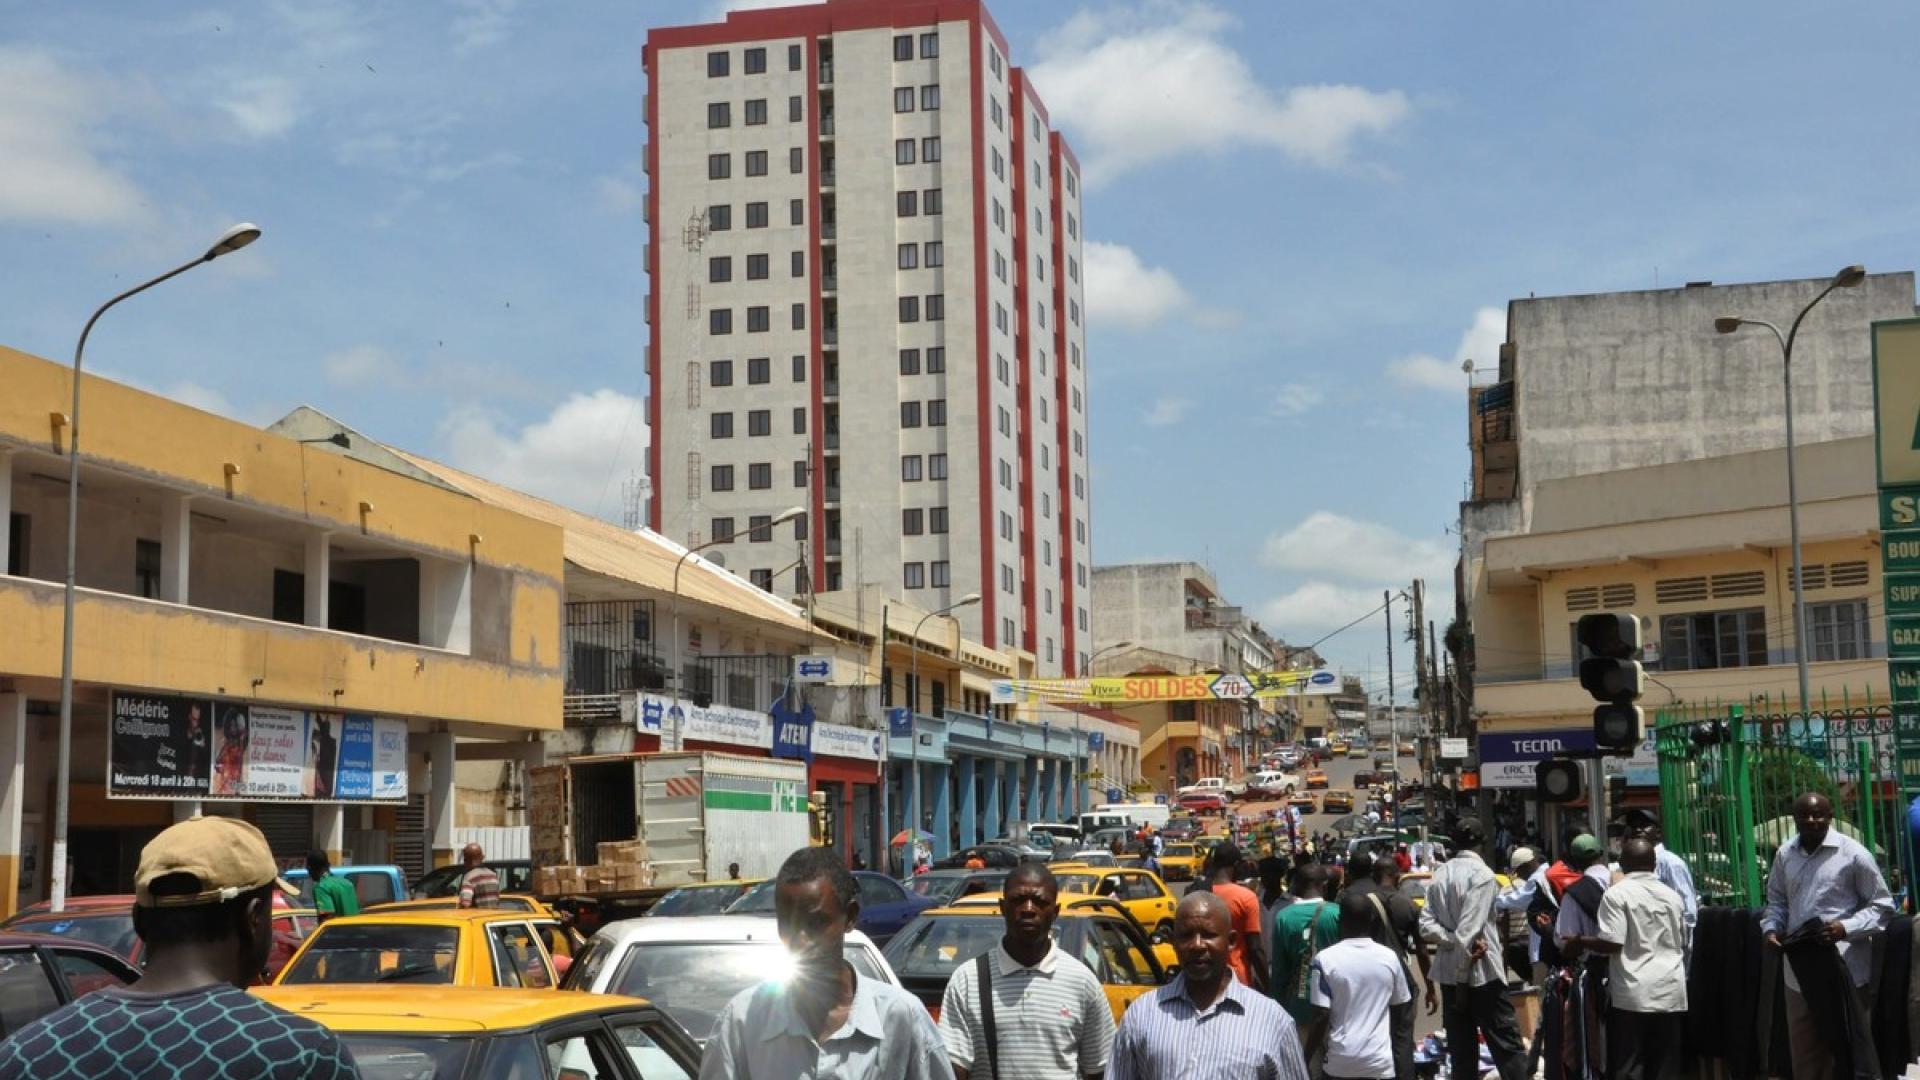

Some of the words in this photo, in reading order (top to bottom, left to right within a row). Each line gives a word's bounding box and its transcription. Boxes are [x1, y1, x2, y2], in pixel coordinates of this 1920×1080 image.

[1890, 496, 1920, 523] S
[1125, 677, 1208, 699] SOLDES
[116, 697, 169, 719] Médéric
[779, 722, 809, 746] ATEM
[114, 773, 150, 786] Mercredi
[151, 774, 160, 786] 18
[160, 774, 177, 787] avril
[1503, 764, 1525, 775] ERIC
